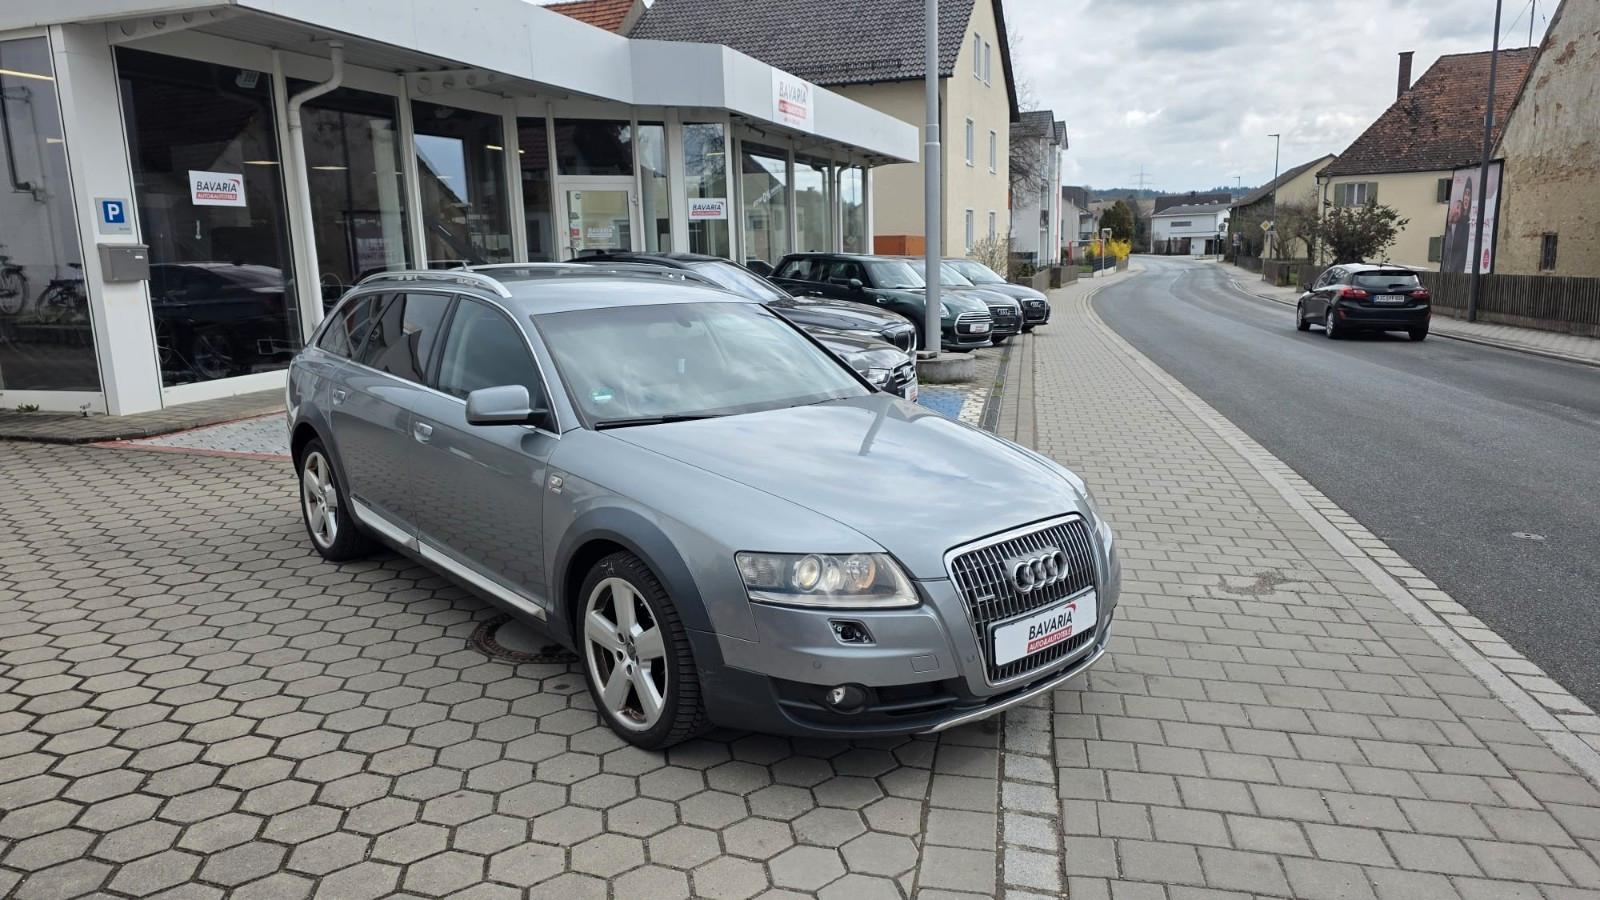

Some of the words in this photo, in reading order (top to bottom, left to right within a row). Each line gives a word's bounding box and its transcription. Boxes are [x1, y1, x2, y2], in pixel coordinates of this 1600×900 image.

[779, 81, 807, 105] BAVARIA
[196, 180, 237, 193] BAVARIA
[107, 203, 120, 221] P
[692, 203, 721, 211] BAVARIA
[1028, 611, 1073, 641] BAVARIA
